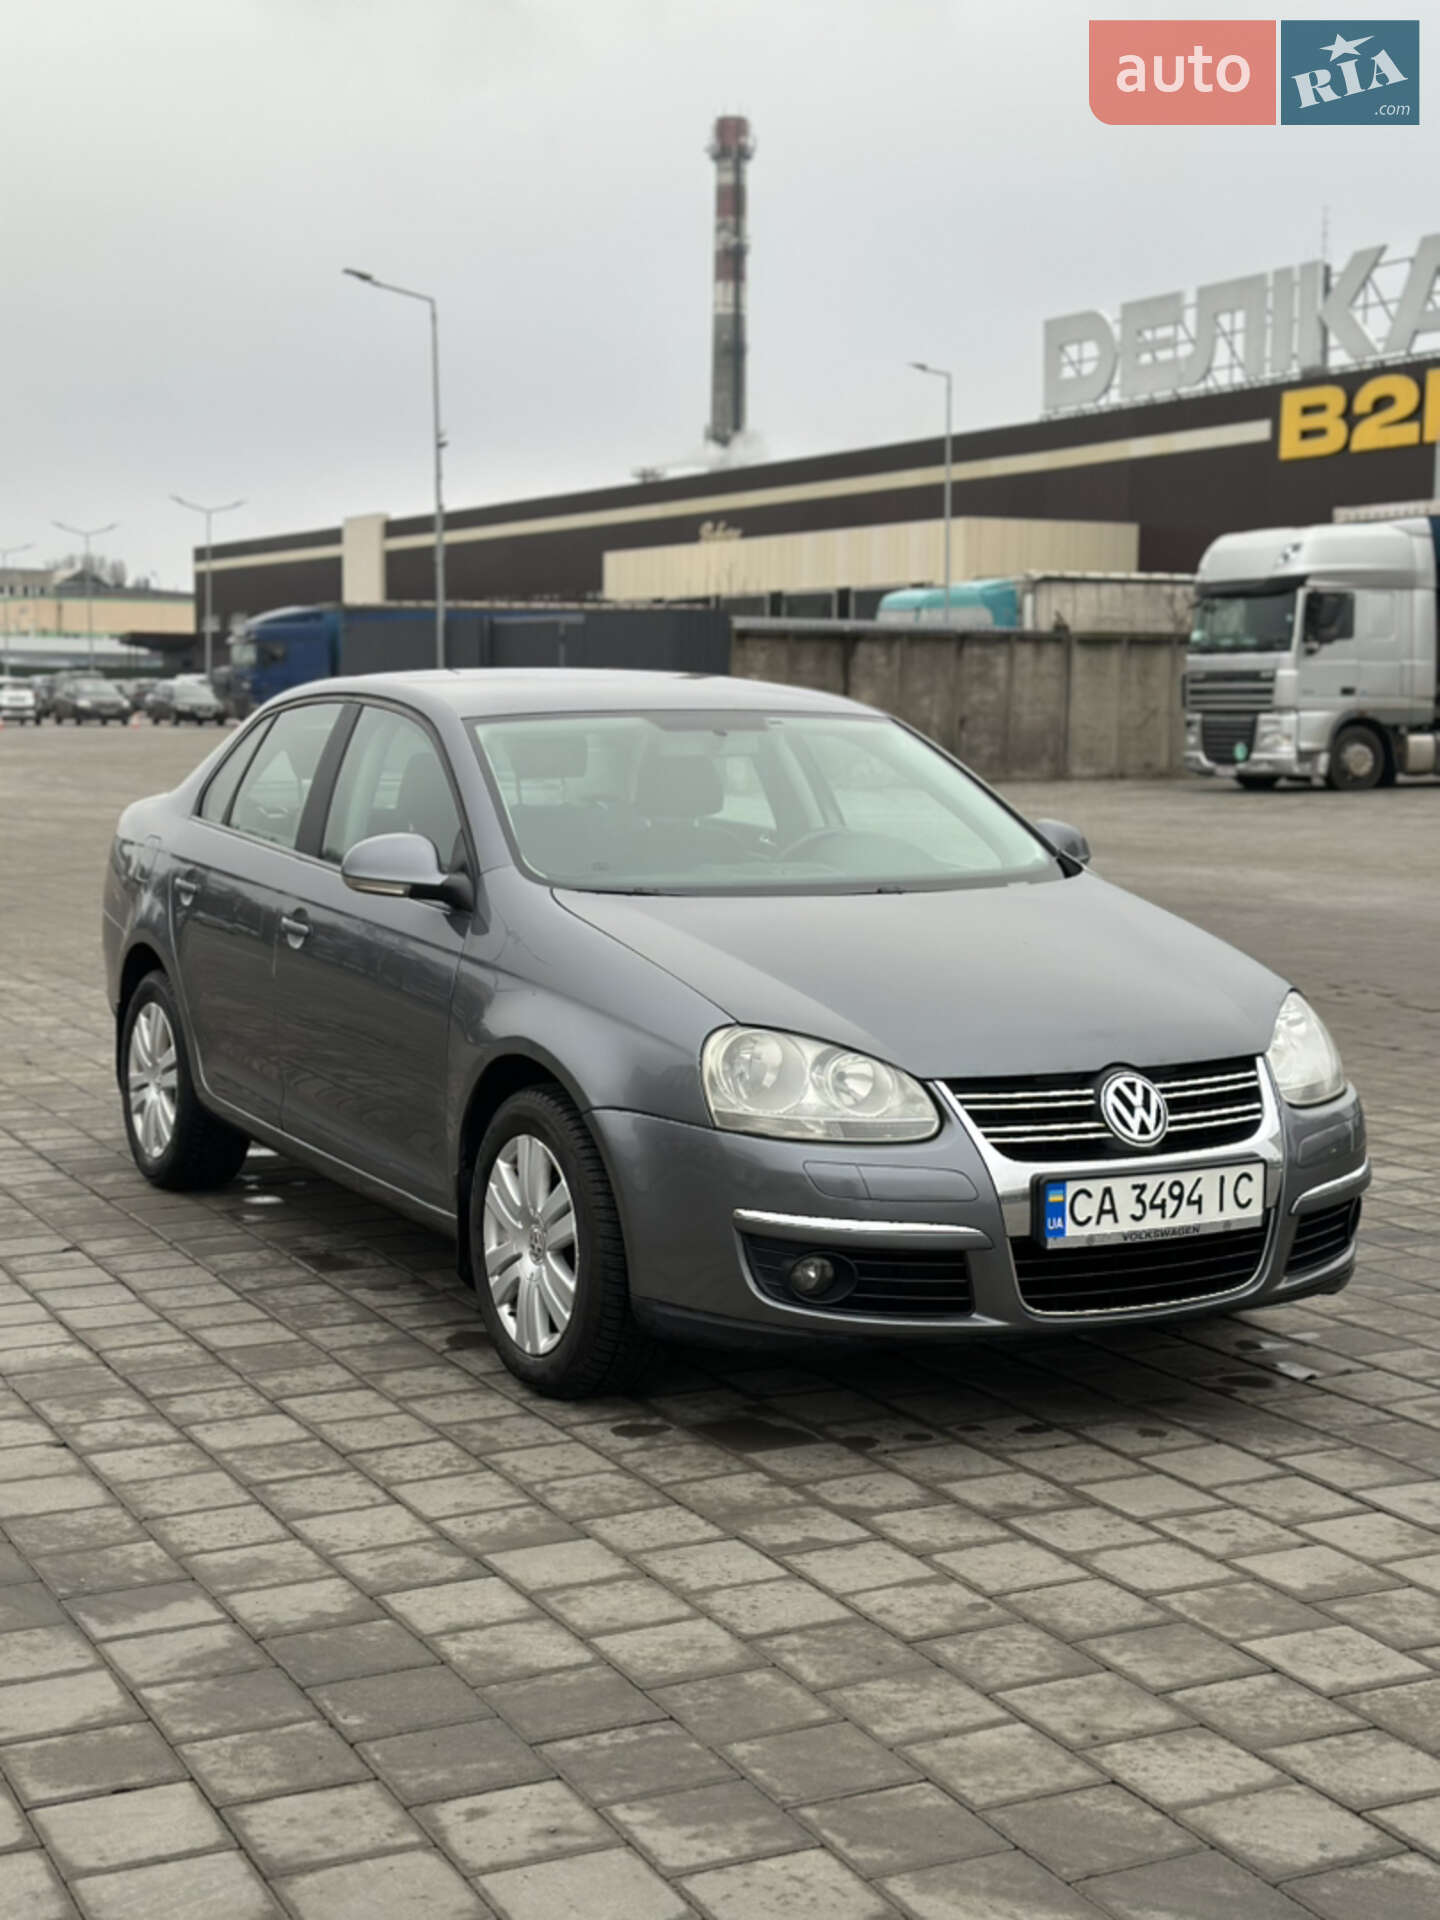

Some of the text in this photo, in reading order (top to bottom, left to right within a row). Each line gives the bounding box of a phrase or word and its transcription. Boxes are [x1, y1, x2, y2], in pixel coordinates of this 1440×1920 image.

[1068, 1185, 1119, 1227] CA
[1129, 1176, 1203, 1222] 3494
[1047, 1216, 1064, 1230] UA
[1121, 1225, 1200, 1242] VOLKSWAGEN
